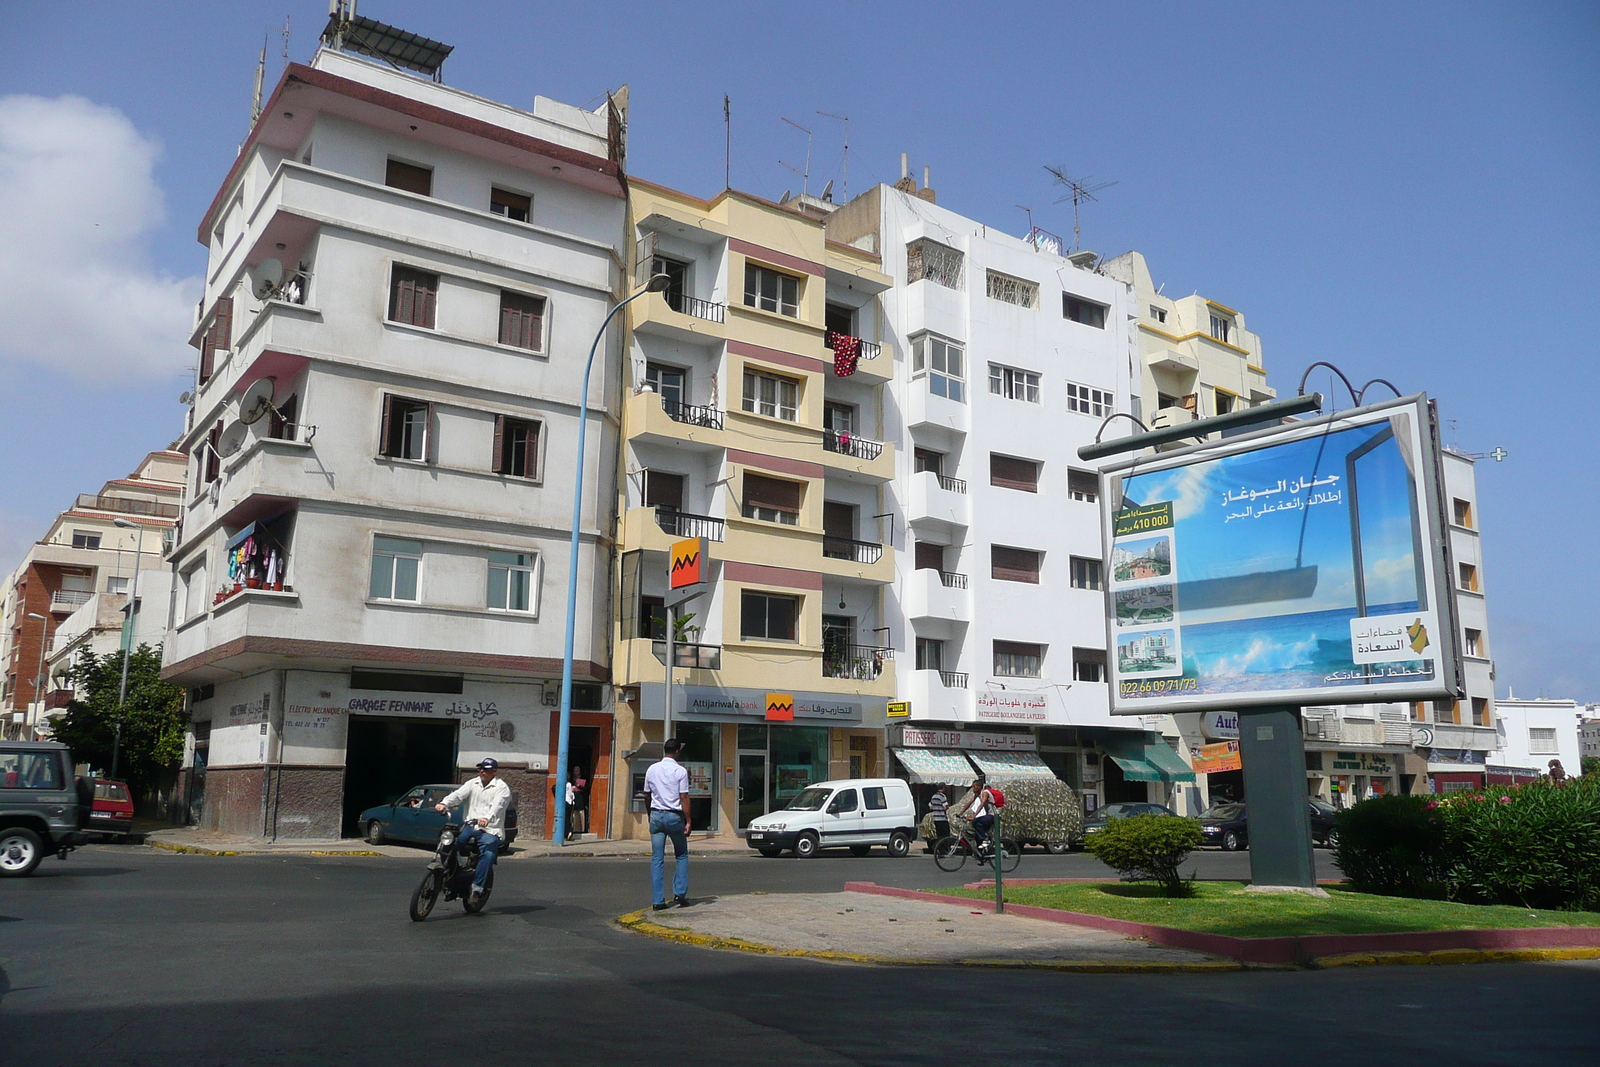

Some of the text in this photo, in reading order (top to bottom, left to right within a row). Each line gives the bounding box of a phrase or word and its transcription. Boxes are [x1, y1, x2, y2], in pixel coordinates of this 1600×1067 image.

[1222, 474, 1340, 506] جنان البوغاز
[1254, 503, 1276, 518] على
[1277, 498, 1304, 510] رائعة
[1224, 506, 1252, 523] البحر
[1116, 515, 1168, 535] 410 000 درهم
[1358, 640, 1404, 654] السعادة
[1120, 678, 1197, 693] 022 66 09 71/73
[348, 698, 434, 713] GARAGE FENNANE
[693, 699, 758, 709] Attijariwafa bank
[1215, 715, 1239, 728] Aut
[905, 730, 936, 745] PATISSERIE
[943, 732, 961, 745] FLEUR
